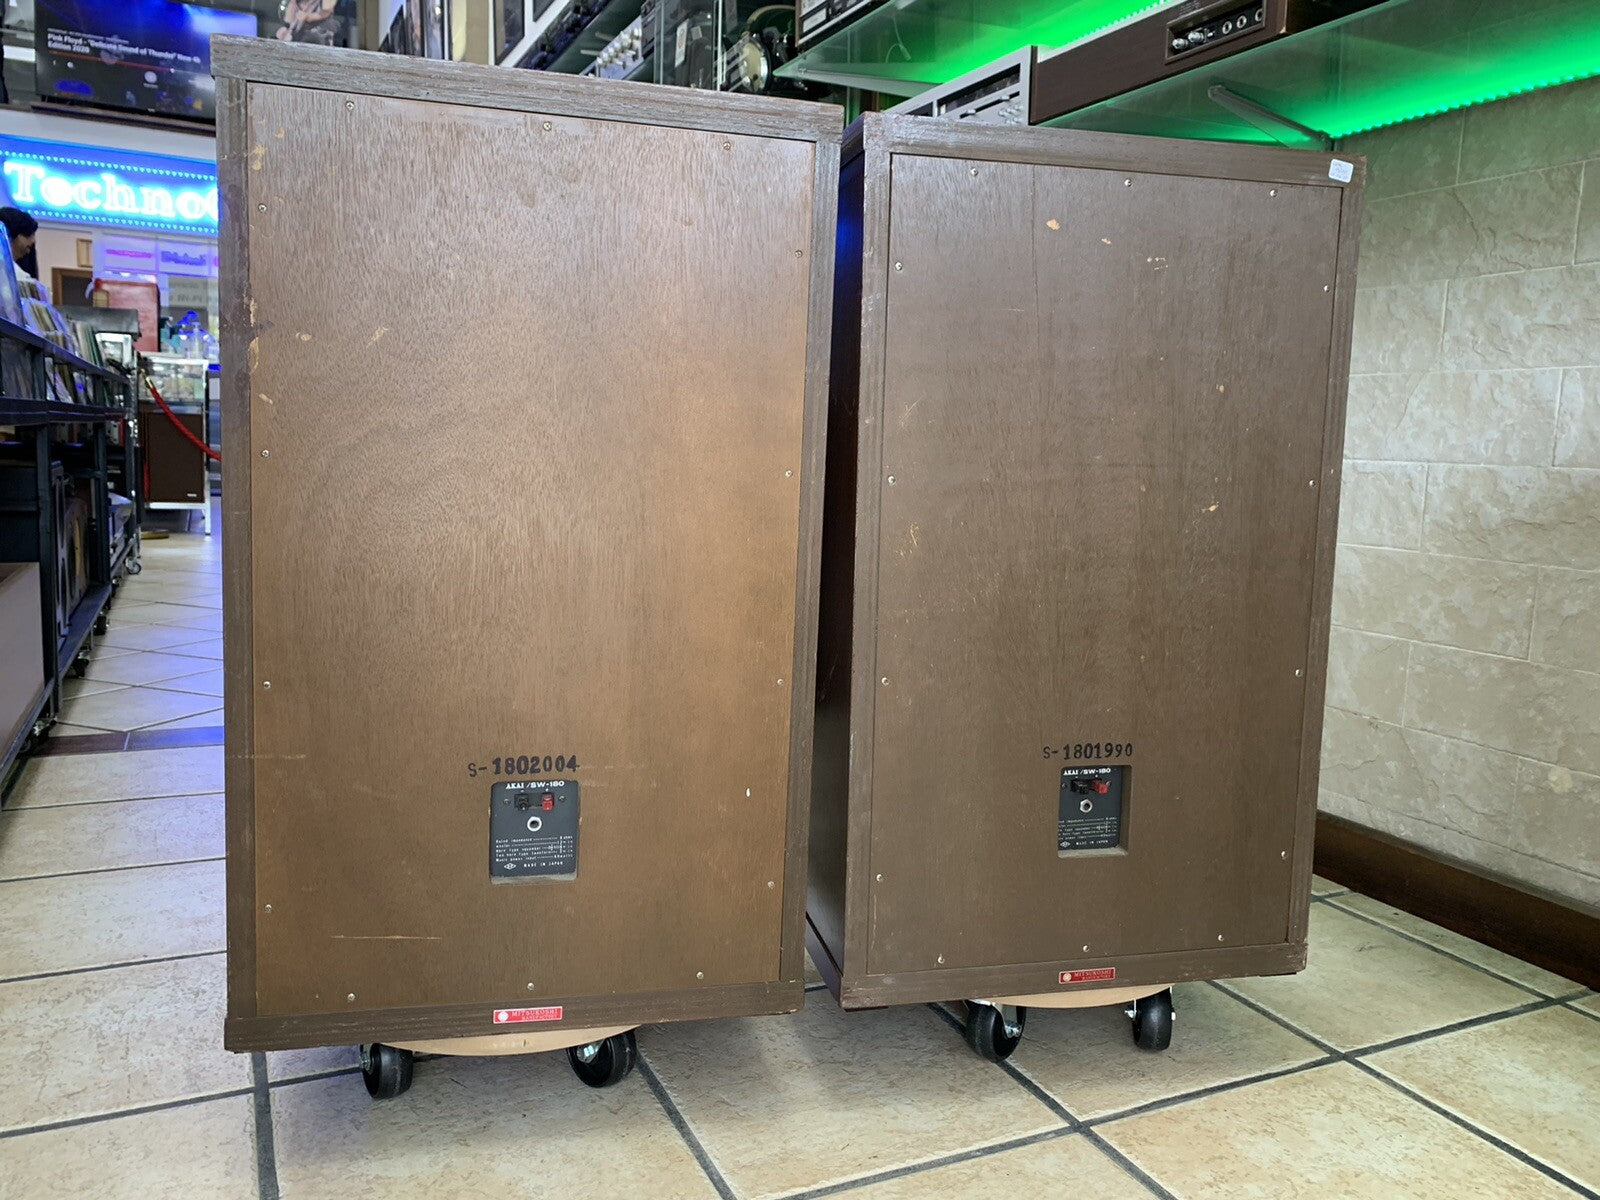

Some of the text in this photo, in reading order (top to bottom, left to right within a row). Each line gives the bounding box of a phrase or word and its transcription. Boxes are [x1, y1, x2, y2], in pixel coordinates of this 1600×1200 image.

[47, 33, 64, 43] Pink
[64, 35, 83, 45] Floyd
[47, 41, 91, 54] Edition 2020
[1063, 768, 1079, 776] AKAI
[506, 782, 524, 790] AKAI
[511, 1009, 558, 1017] MITSUKOSHI
